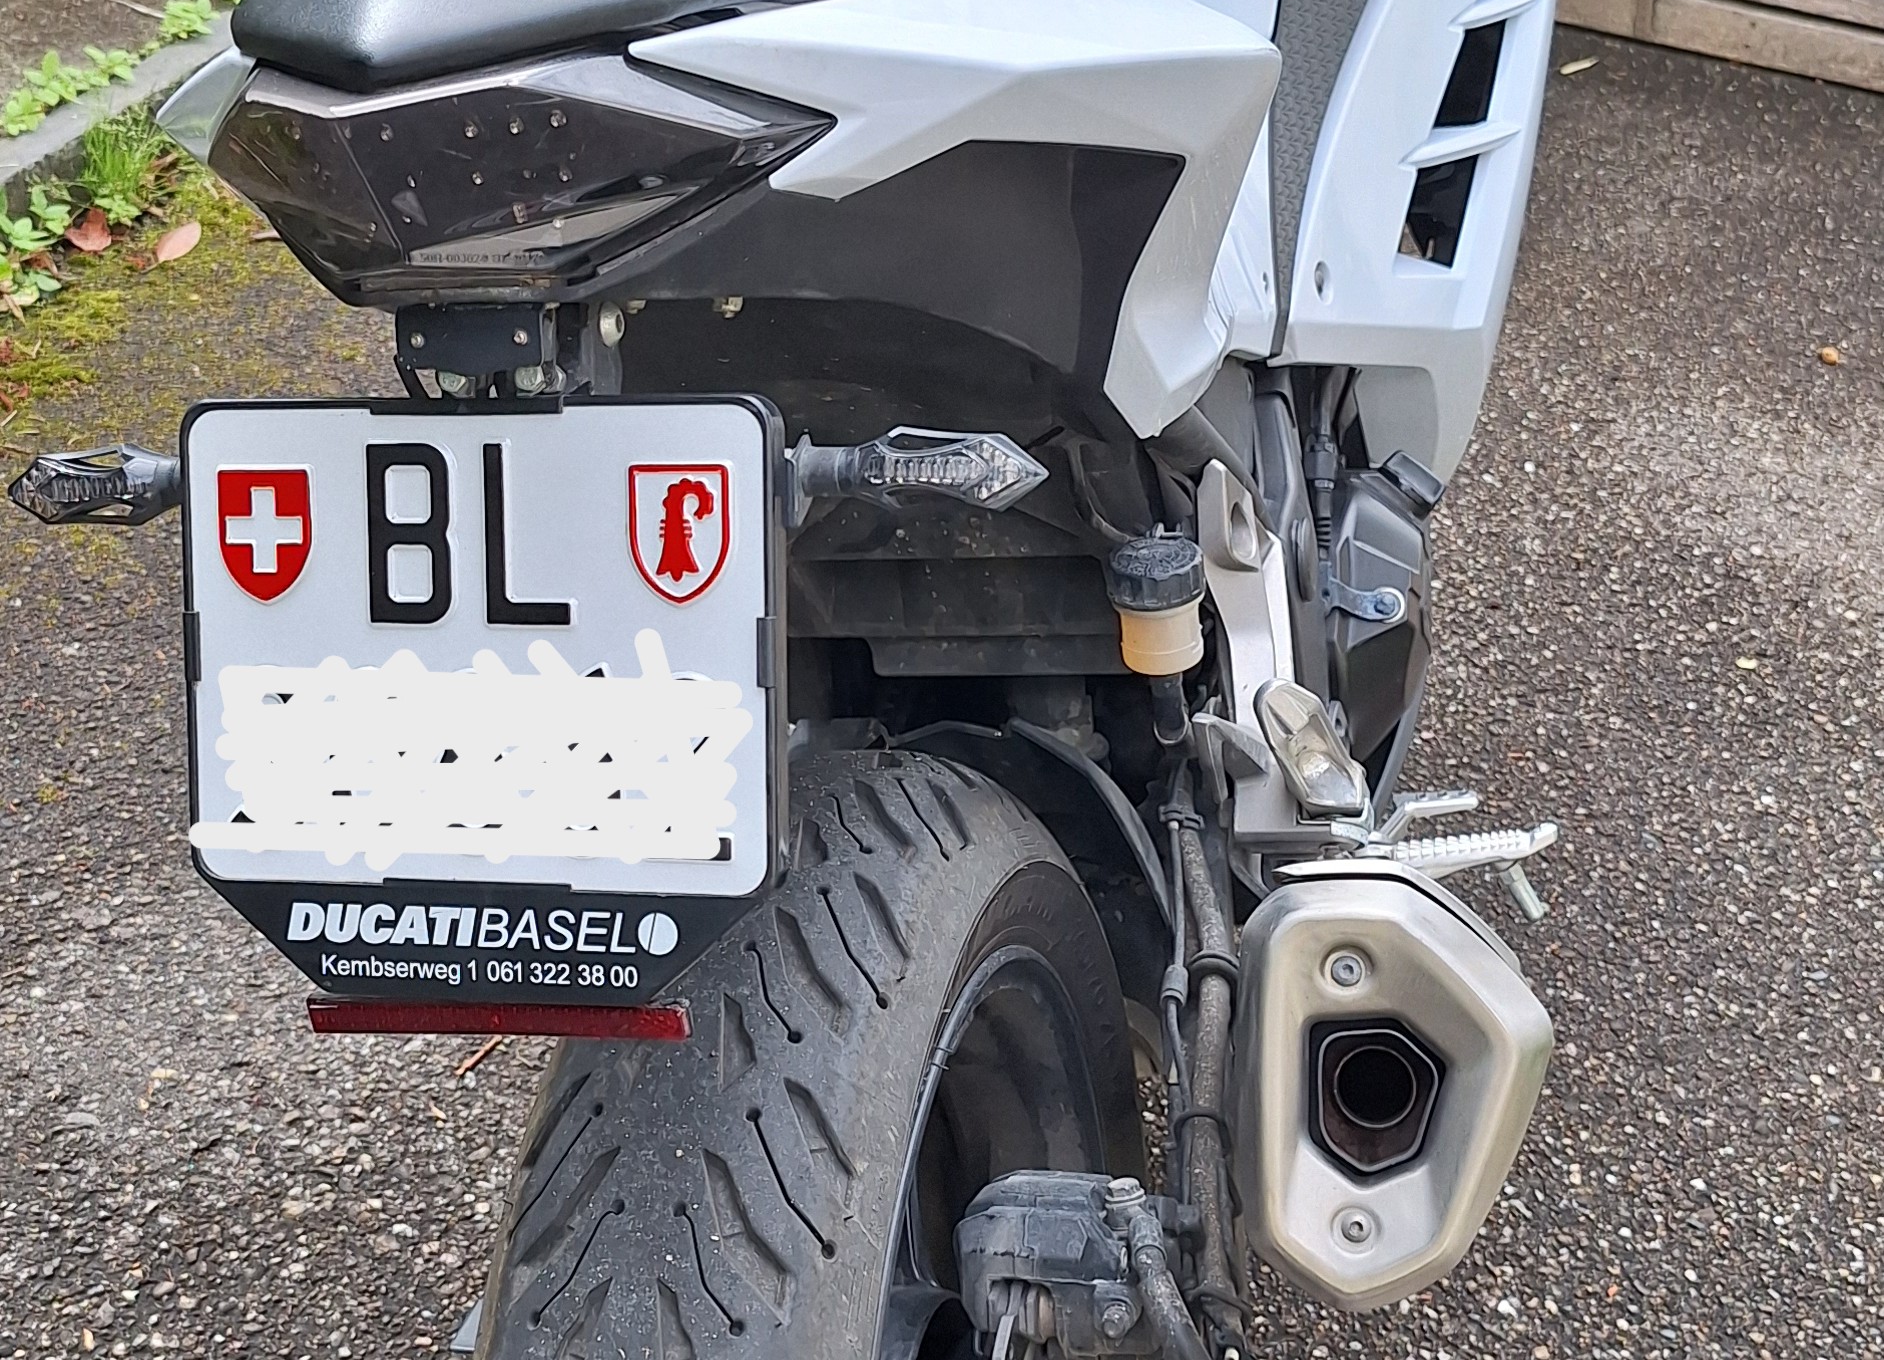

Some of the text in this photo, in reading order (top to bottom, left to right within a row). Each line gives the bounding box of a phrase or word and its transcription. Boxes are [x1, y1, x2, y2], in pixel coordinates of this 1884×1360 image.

[365, 442, 572, 625] BL
[321, 953, 639, 988] Kembserweg 1 061 322 38 00
